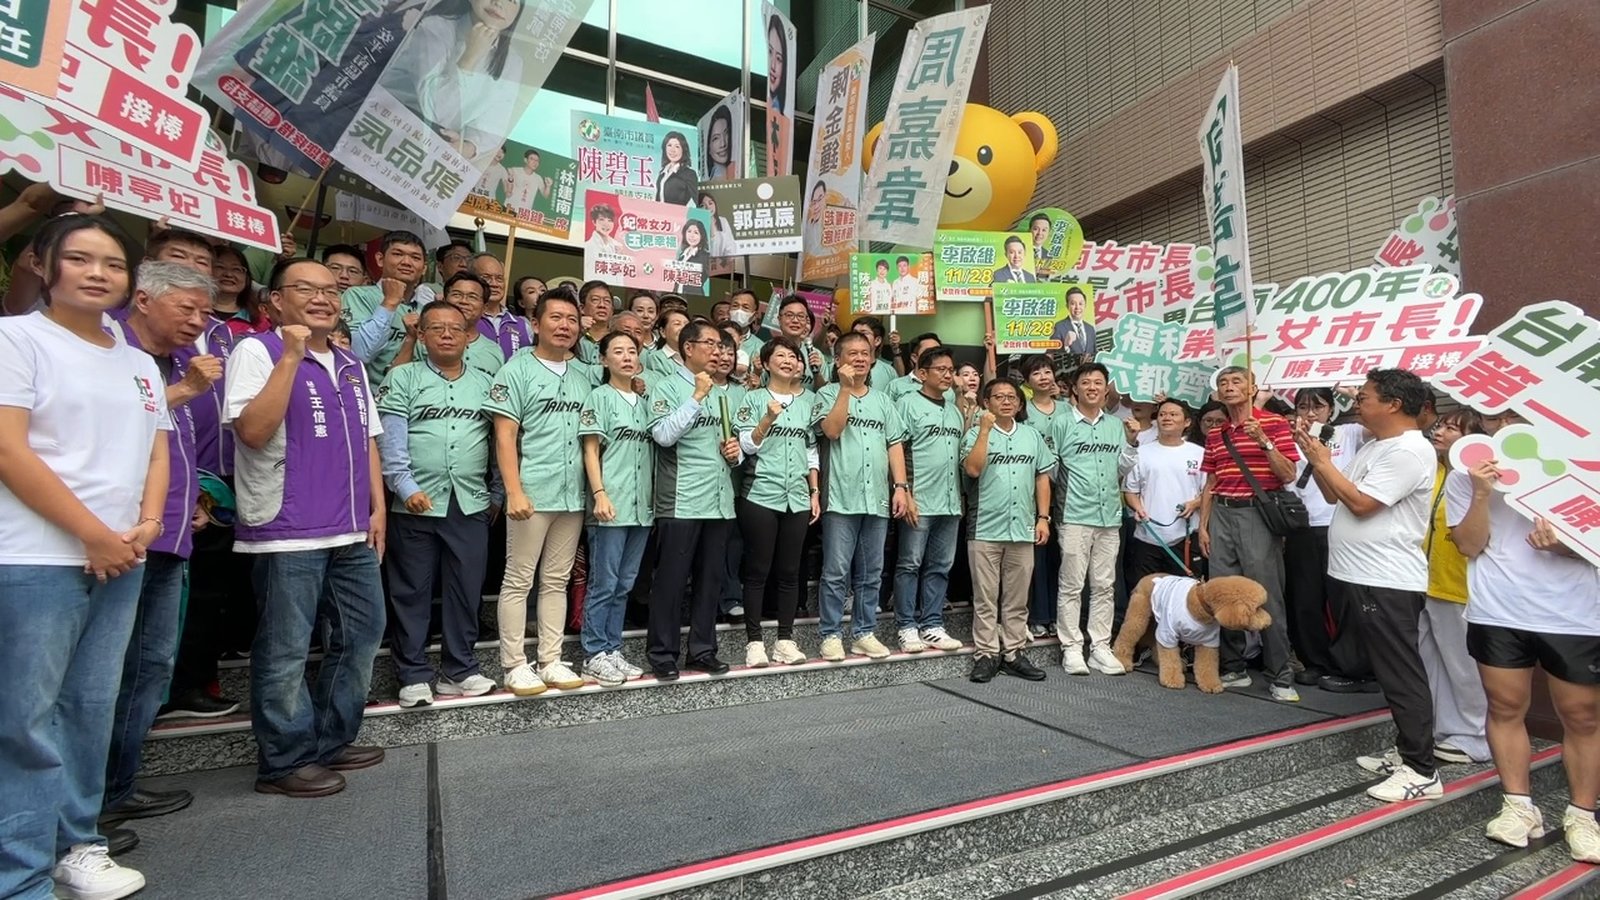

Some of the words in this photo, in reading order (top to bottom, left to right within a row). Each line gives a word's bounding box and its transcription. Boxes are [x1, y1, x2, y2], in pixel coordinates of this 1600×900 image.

[119, 92, 184, 142] 接棒
[578, 146, 655, 189] 陳碧玉
[85, 160, 202, 219] 陳亭妃
[556, 170, 575, 215] 林建南
[226, 210, 265, 236] 接棒
[733, 207, 795, 230] 郭品辰
[595, 261, 636, 278] 陳亭妃
[663, 269, 702, 286] 陳碧玉
[944, 267, 993, 285] 11/28
[1188, 265, 1425, 323] 台400年
[1006, 319, 1055, 337] 11/28
[1282, 354, 1384, 379] 陳亭妃
[1408, 349, 1463, 371] 接棒
[846, 415, 884, 430] AINAN
[988, 452, 1035, 464] TAINAN
[1073, 442, 1119, 454] TAINAN
